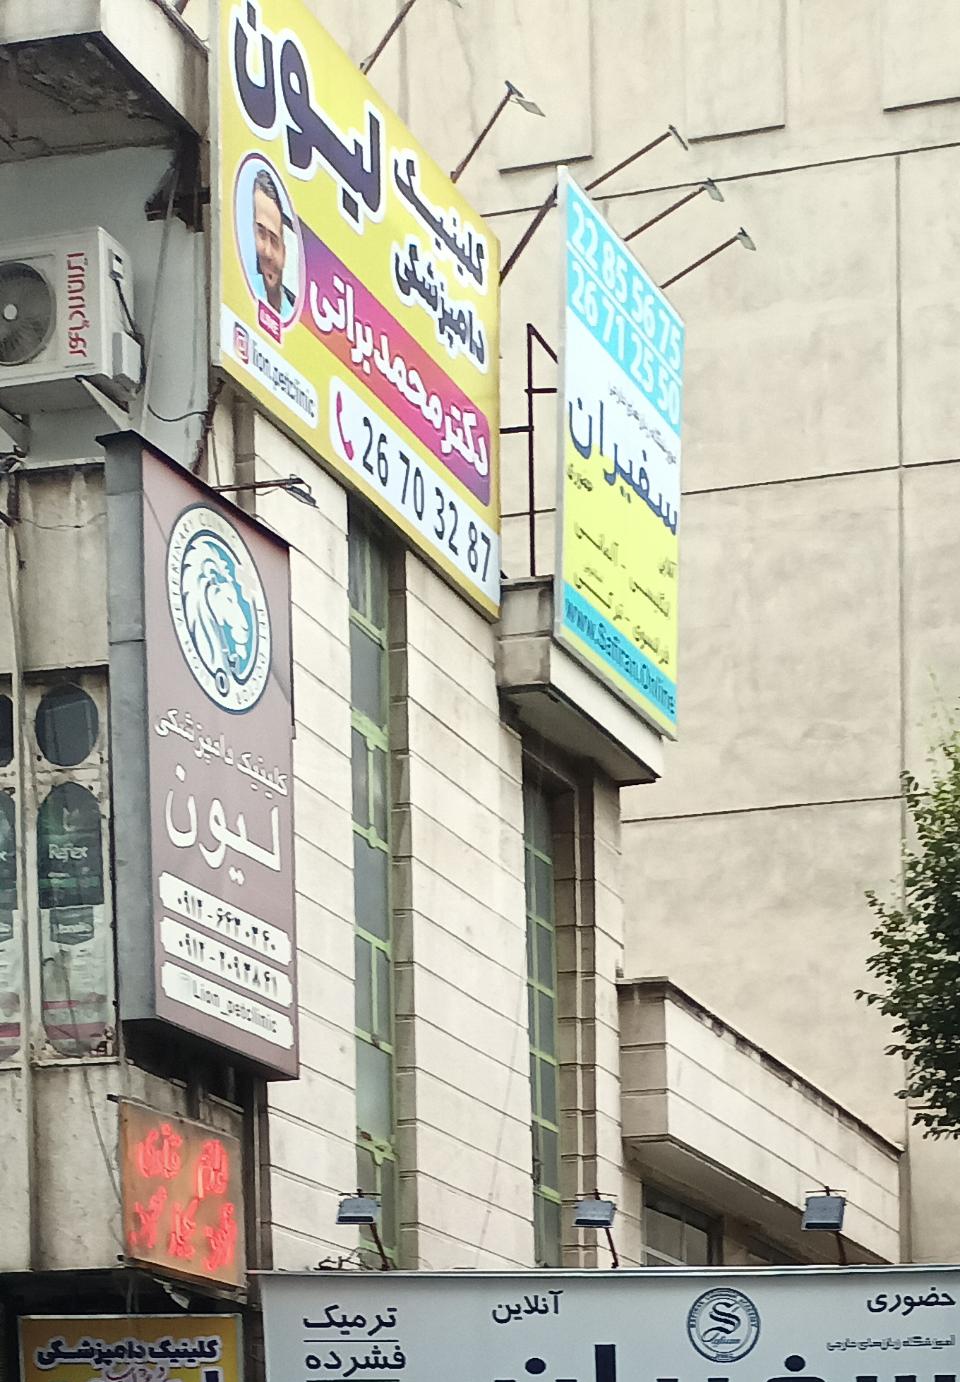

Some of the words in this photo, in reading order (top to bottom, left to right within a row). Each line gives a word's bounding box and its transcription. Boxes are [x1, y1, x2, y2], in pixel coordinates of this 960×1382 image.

[234, 0, 381, 223] لیون
[394, 159, 485, 286] کلینیک
[394, 243, 485, 365] دامپزشکی
[572, 202, 598, 271] 22
[602, 240, 628, 304] 85
[631, 275, 656, 339] 56
[658, 307, 681, 371] 75
[571, 260, 598, 327] 26
[602, 300, 625, 361] 71
[630, 331, 654, 393] 25
[657, 371, 680, 425] 50
[362, 416, 389, 487] 26
[399, 449, 425, 521] 70
[434, 486, 459, 556] 32
[467, 521, 492, 583] 87
[568, 397, 678, 536] سفیران
[154, 708, 234, 766] دامپزشکی
[237, 751, 288, 797] کلینیک
[165, 763, 281, 886] لیون
[302, 1304, 398, 1336] ترمیک
[492, 1289, 564, 1324] آنلاین
[866, 1286, 957, 1317] حضوری
[37, 1339, 146, 1366] دامپزشکی
[148, 1339, 219, 1363] کلینیک
[304, 1345, 406, 1378] فشرده
